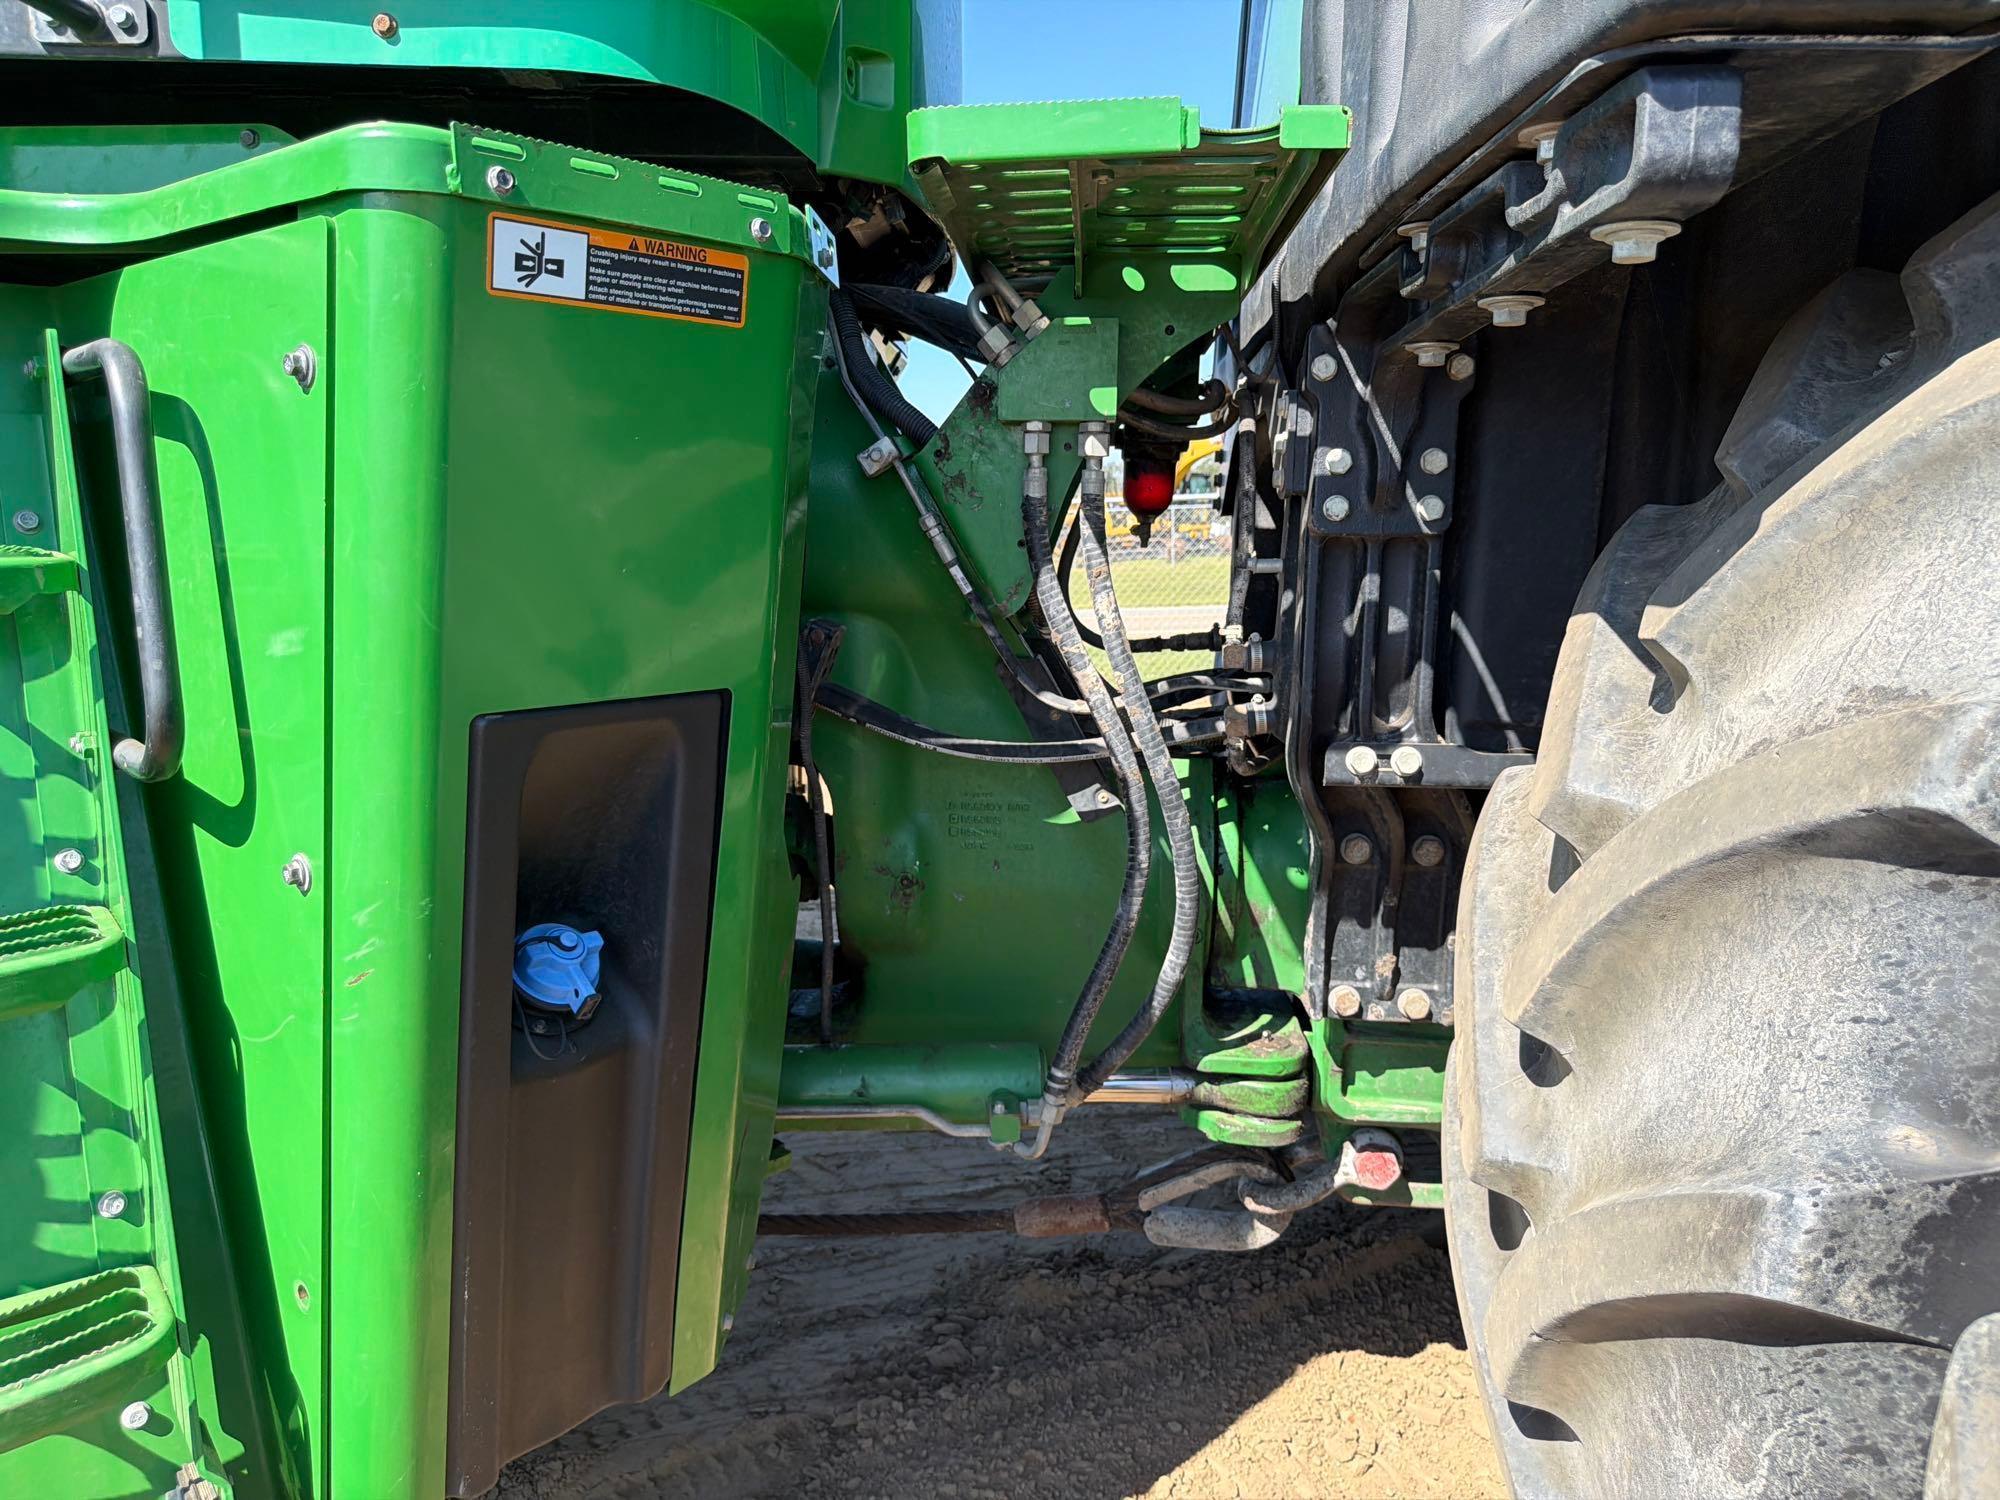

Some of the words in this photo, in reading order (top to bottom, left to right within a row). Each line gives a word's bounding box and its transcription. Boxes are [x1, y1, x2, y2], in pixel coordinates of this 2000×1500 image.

[644, 239, 707, 262] WARNING
[590, 248, 618, 260] Crushing
[620, 253, 637, 263] injury
[677, 263, 693, 271] hinge
[713, 269, 735, 278] machine
[620, 280, 641, 289] moving
[643, 283, 666, 292] steering
[677, 280, 700, 289] machine
[701, 284, 718, 292] before
[720, 288, 740, 296] starting
[610, 288, 633, 298] steering
[634, 291, 658, 300] lockouts
[678, 299, 706, 308] performing
[616, 297, 640, 305] machine
[649, 302, 682, 312] transporting
